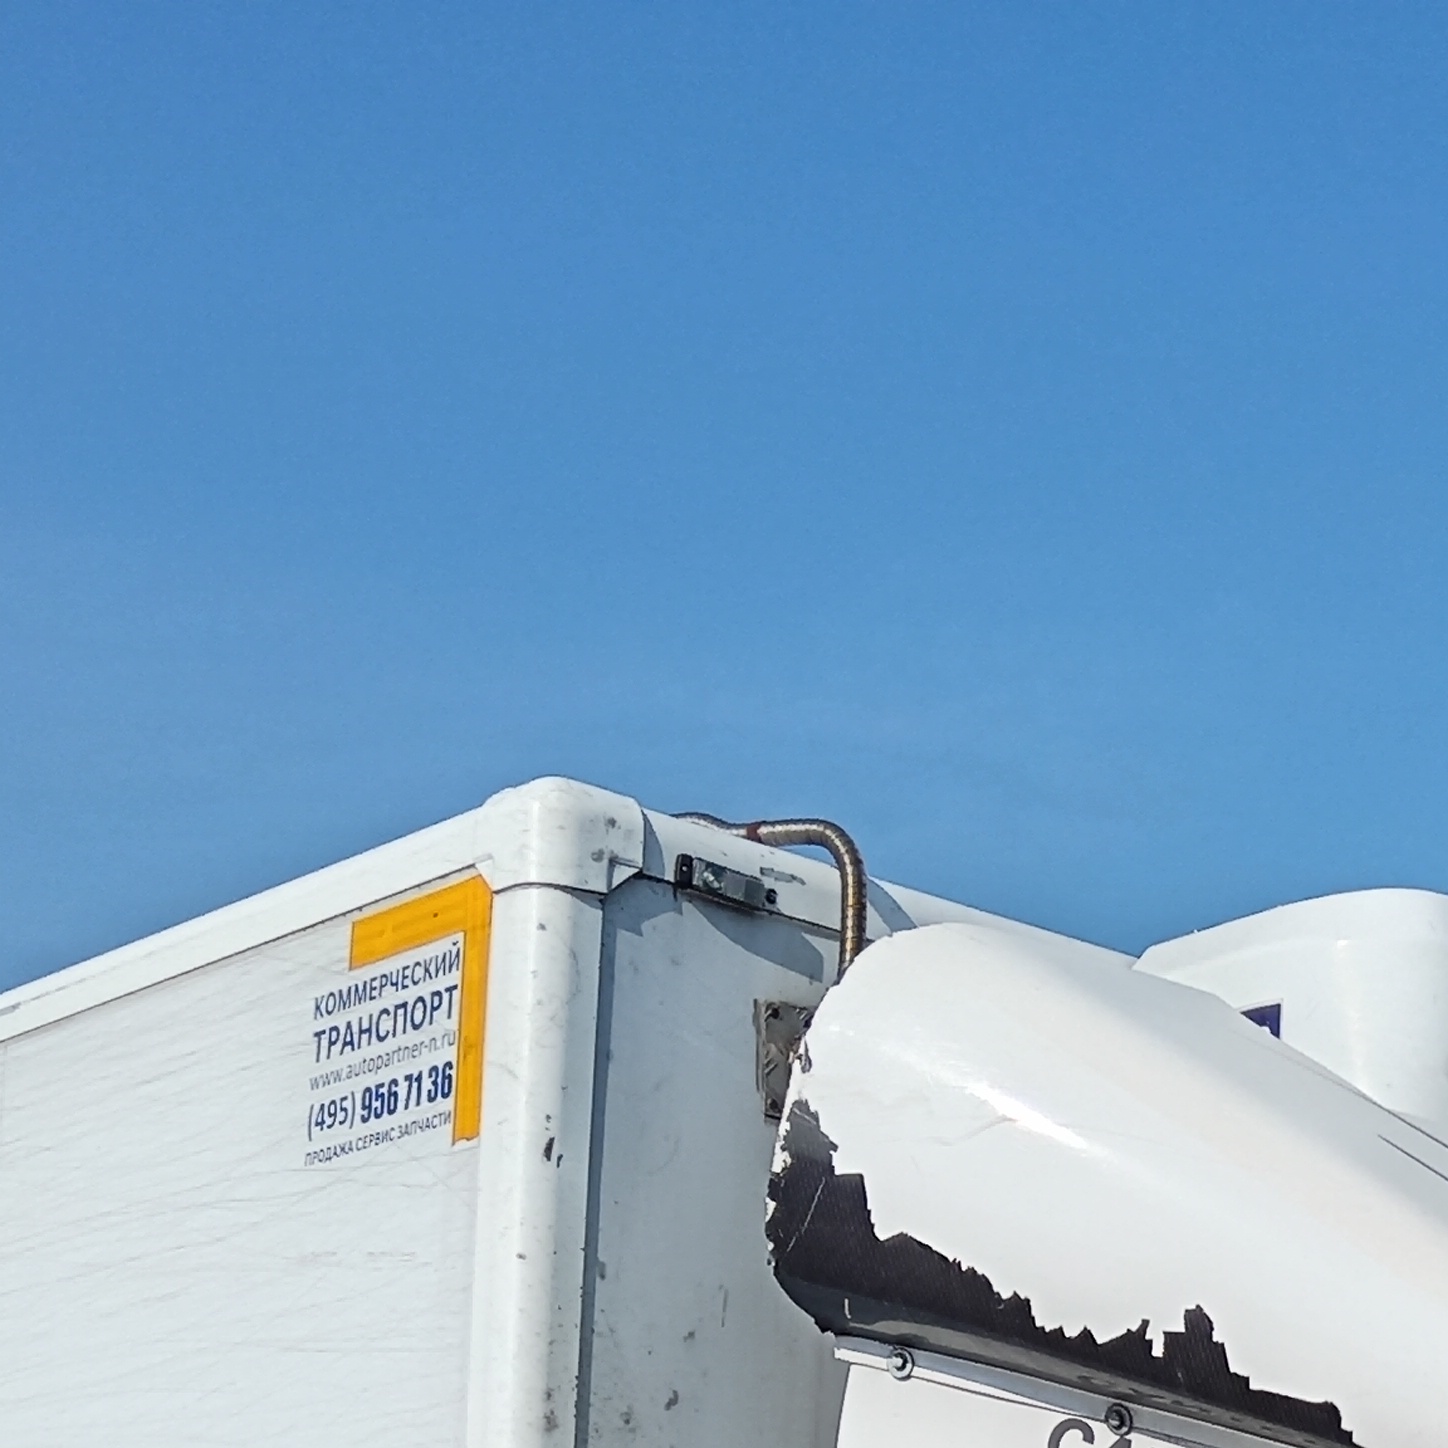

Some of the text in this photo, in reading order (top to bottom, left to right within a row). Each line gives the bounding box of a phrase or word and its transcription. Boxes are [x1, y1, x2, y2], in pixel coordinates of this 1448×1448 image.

[314, 941, 461, 1020] КОММЕРЧЕСКИЙ
[314, 984, 458, 1063] ТРАНСПОРТ
[309, 1031, 456, 1091] www.autopartner-n.ru
[304, 1110, 452, 1167] ПРОДАЖА СЕРВИС ЗАПЧАСТИ
[307, 1091, 356, 1141] (495)
[360, 1079, 399, 1124] 956
